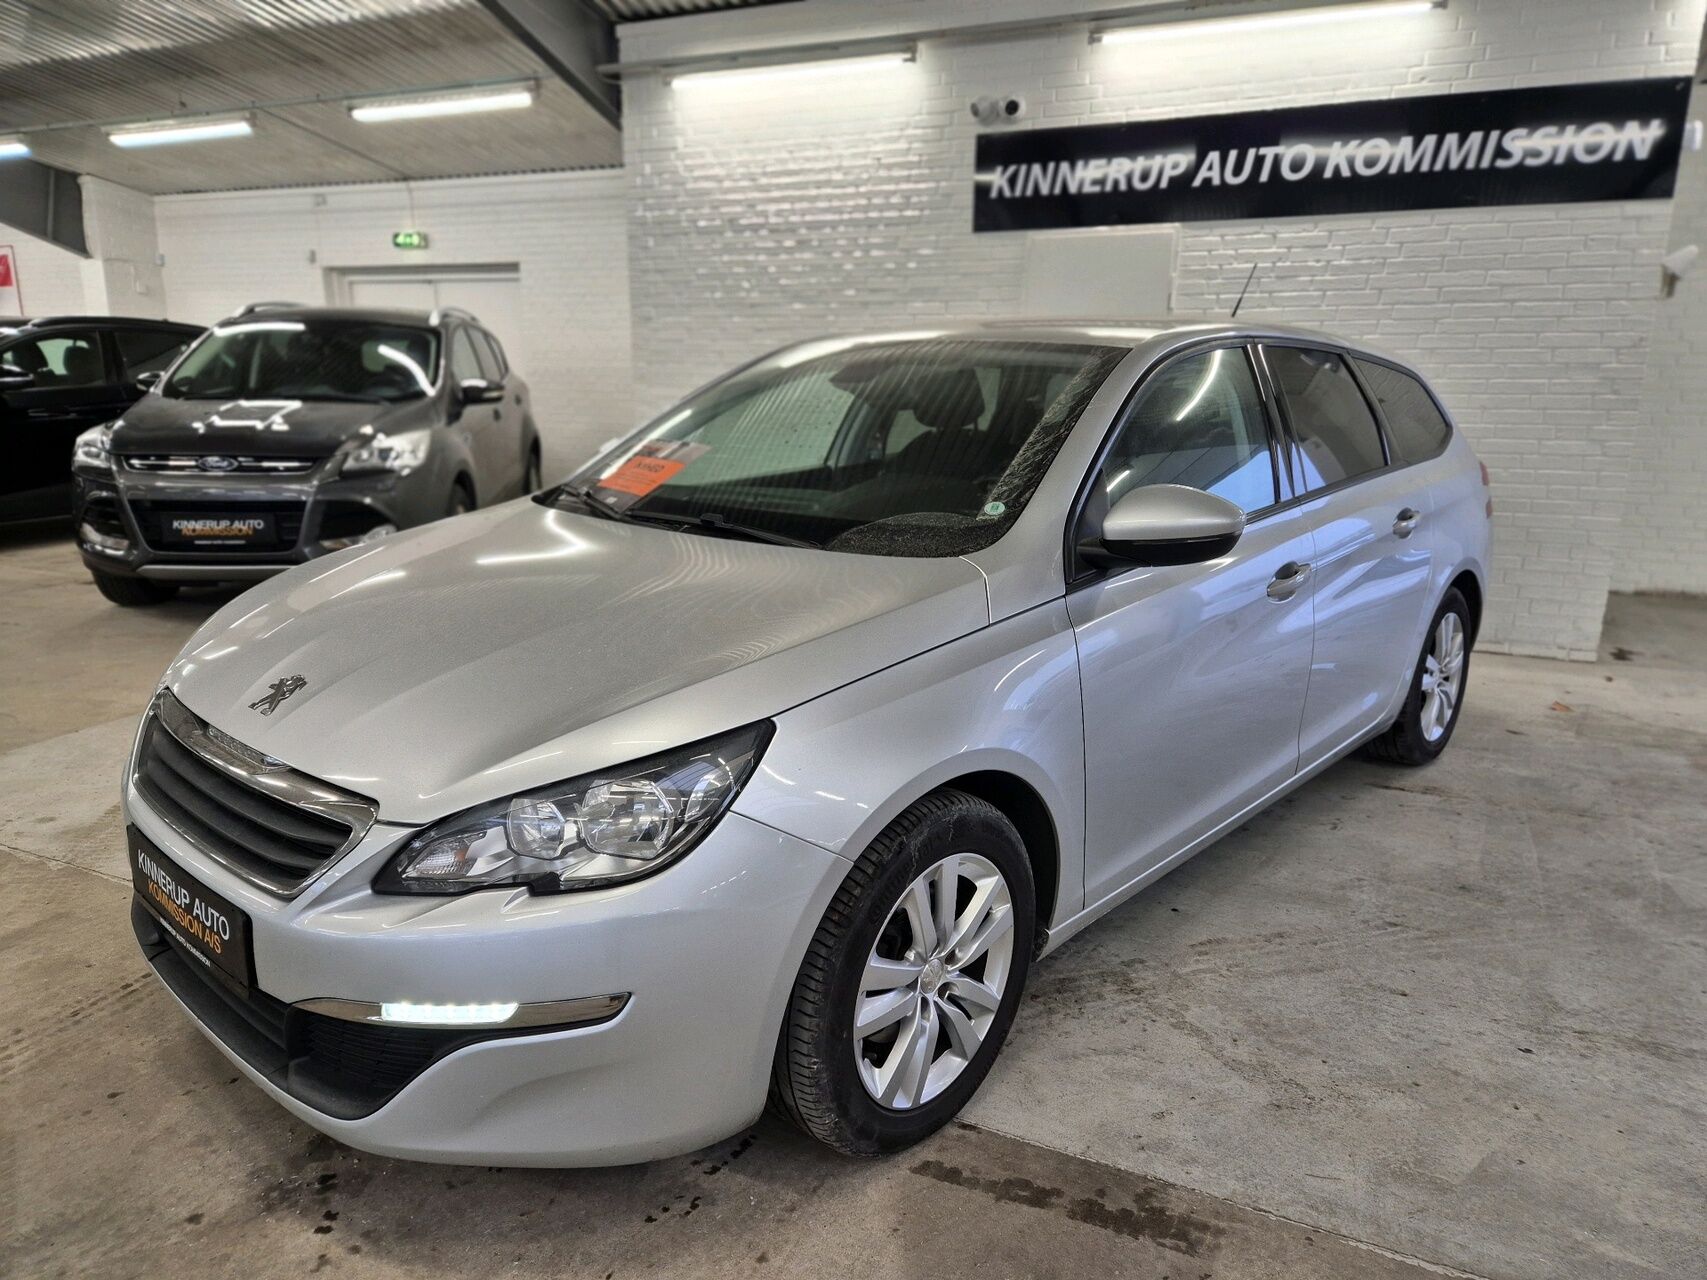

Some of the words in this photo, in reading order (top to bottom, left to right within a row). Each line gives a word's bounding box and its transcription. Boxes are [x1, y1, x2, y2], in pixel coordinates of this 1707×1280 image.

[989, 153, 1188, 199] KINNERUP
[1192, 143, 1315, 187] AUTO
[1322, 118, 1663, 179] KOMMISSION
[172, 519, 231, 529] KINNERUP
[232, 519, 265, 529] AUTO
[137, 849, 190, 908] KINNERUP
[192, 897, 230, 941] AUTO
[148, 880, 203, 940] KOMMISSION
[203, 927, 222, 954] A/S
